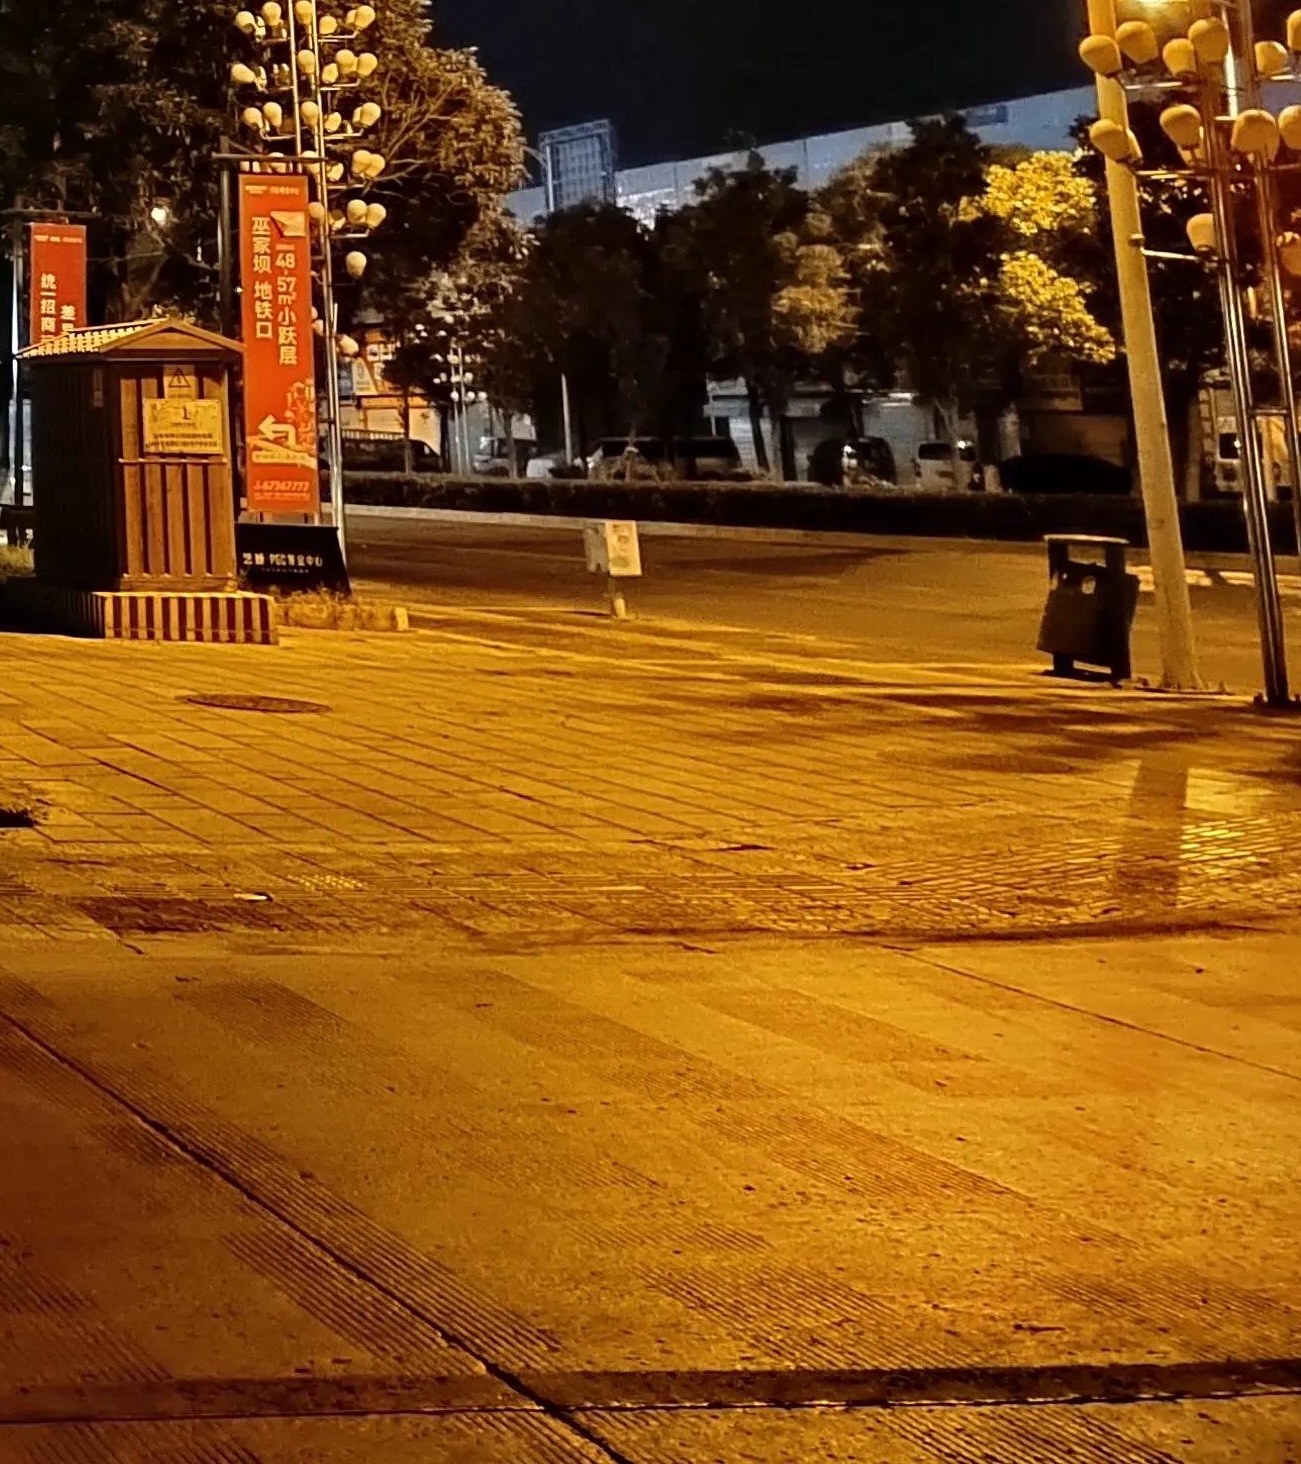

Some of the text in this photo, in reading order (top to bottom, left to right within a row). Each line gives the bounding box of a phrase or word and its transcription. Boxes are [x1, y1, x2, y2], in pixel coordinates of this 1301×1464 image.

[251, 216, 272, 274] 巫家坝
[253, 280, 274, 339] 地铁口
